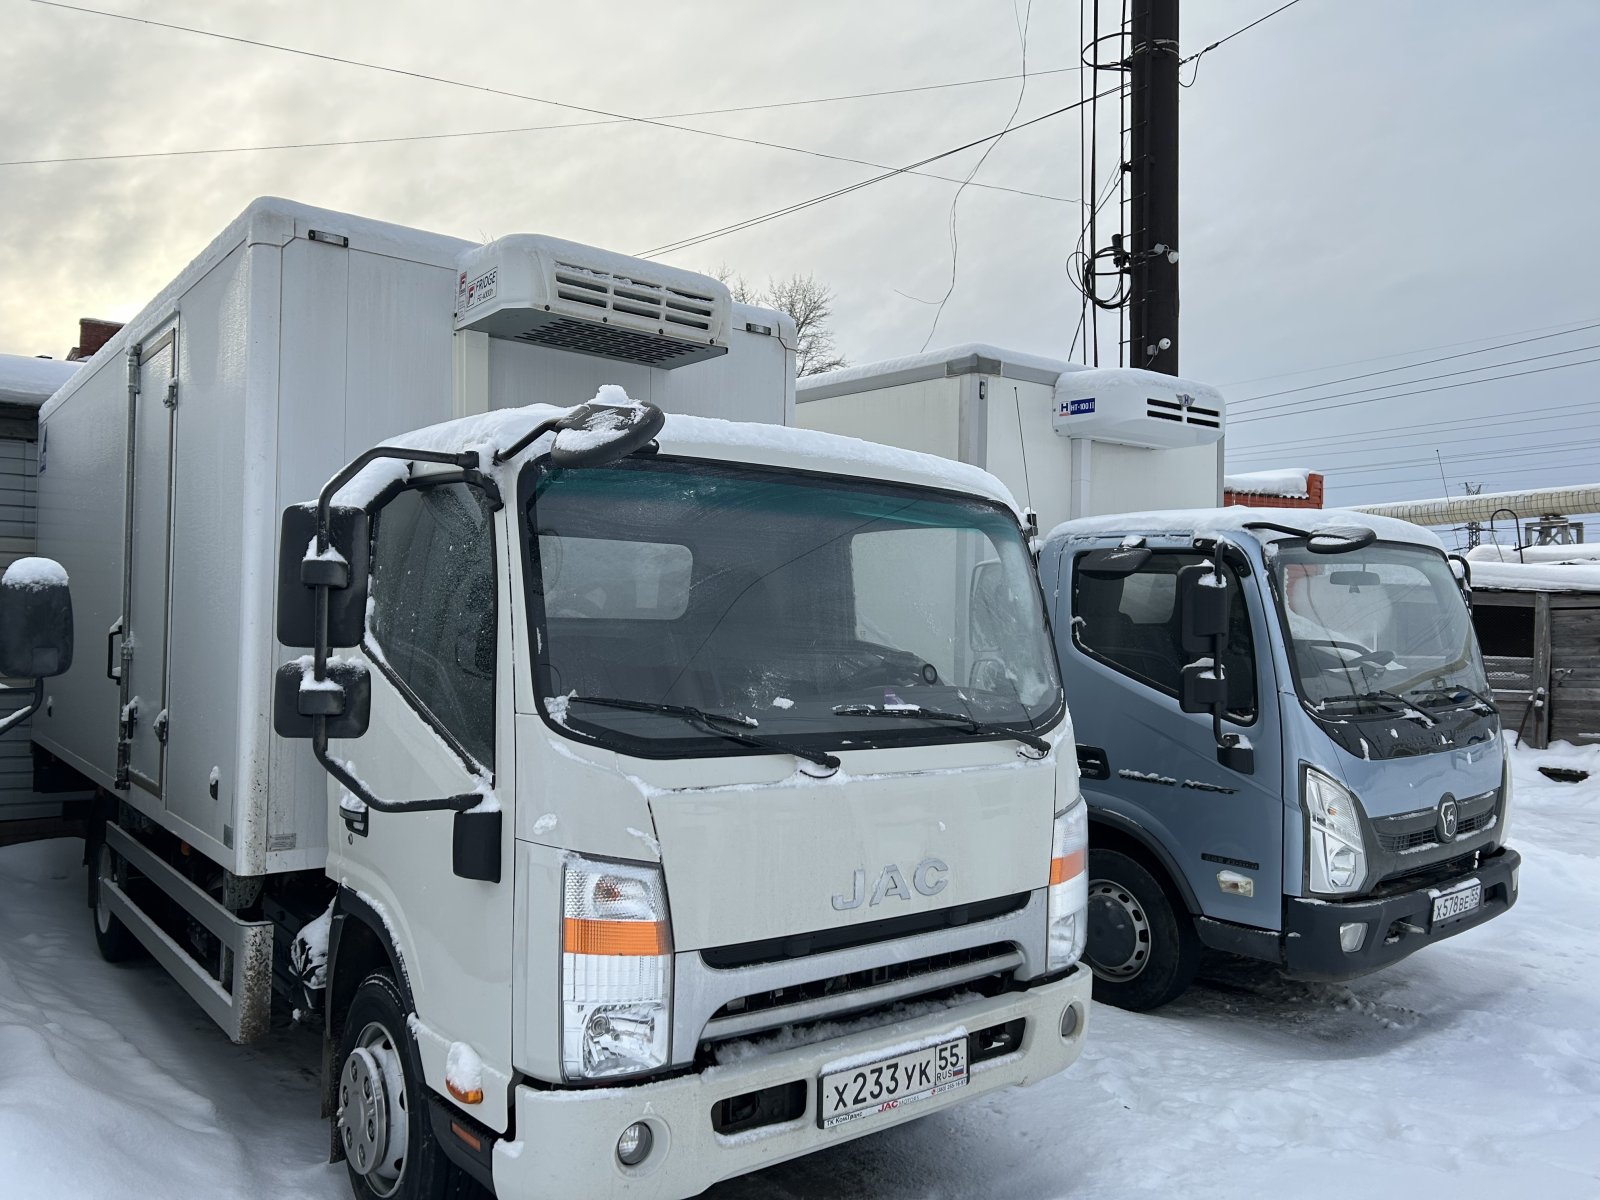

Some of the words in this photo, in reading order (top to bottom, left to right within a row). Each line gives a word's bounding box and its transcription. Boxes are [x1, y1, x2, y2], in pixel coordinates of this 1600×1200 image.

[476, 270, 497, 291] FRIDGE
[1061, 402, 1069, 412] H
[831, 858, 949, 911] JAC
[938, 1044, 960, 1071] 55
[936, 1069, 953, 1082] RUS
[878, 1100, 899, 1113] JAC
